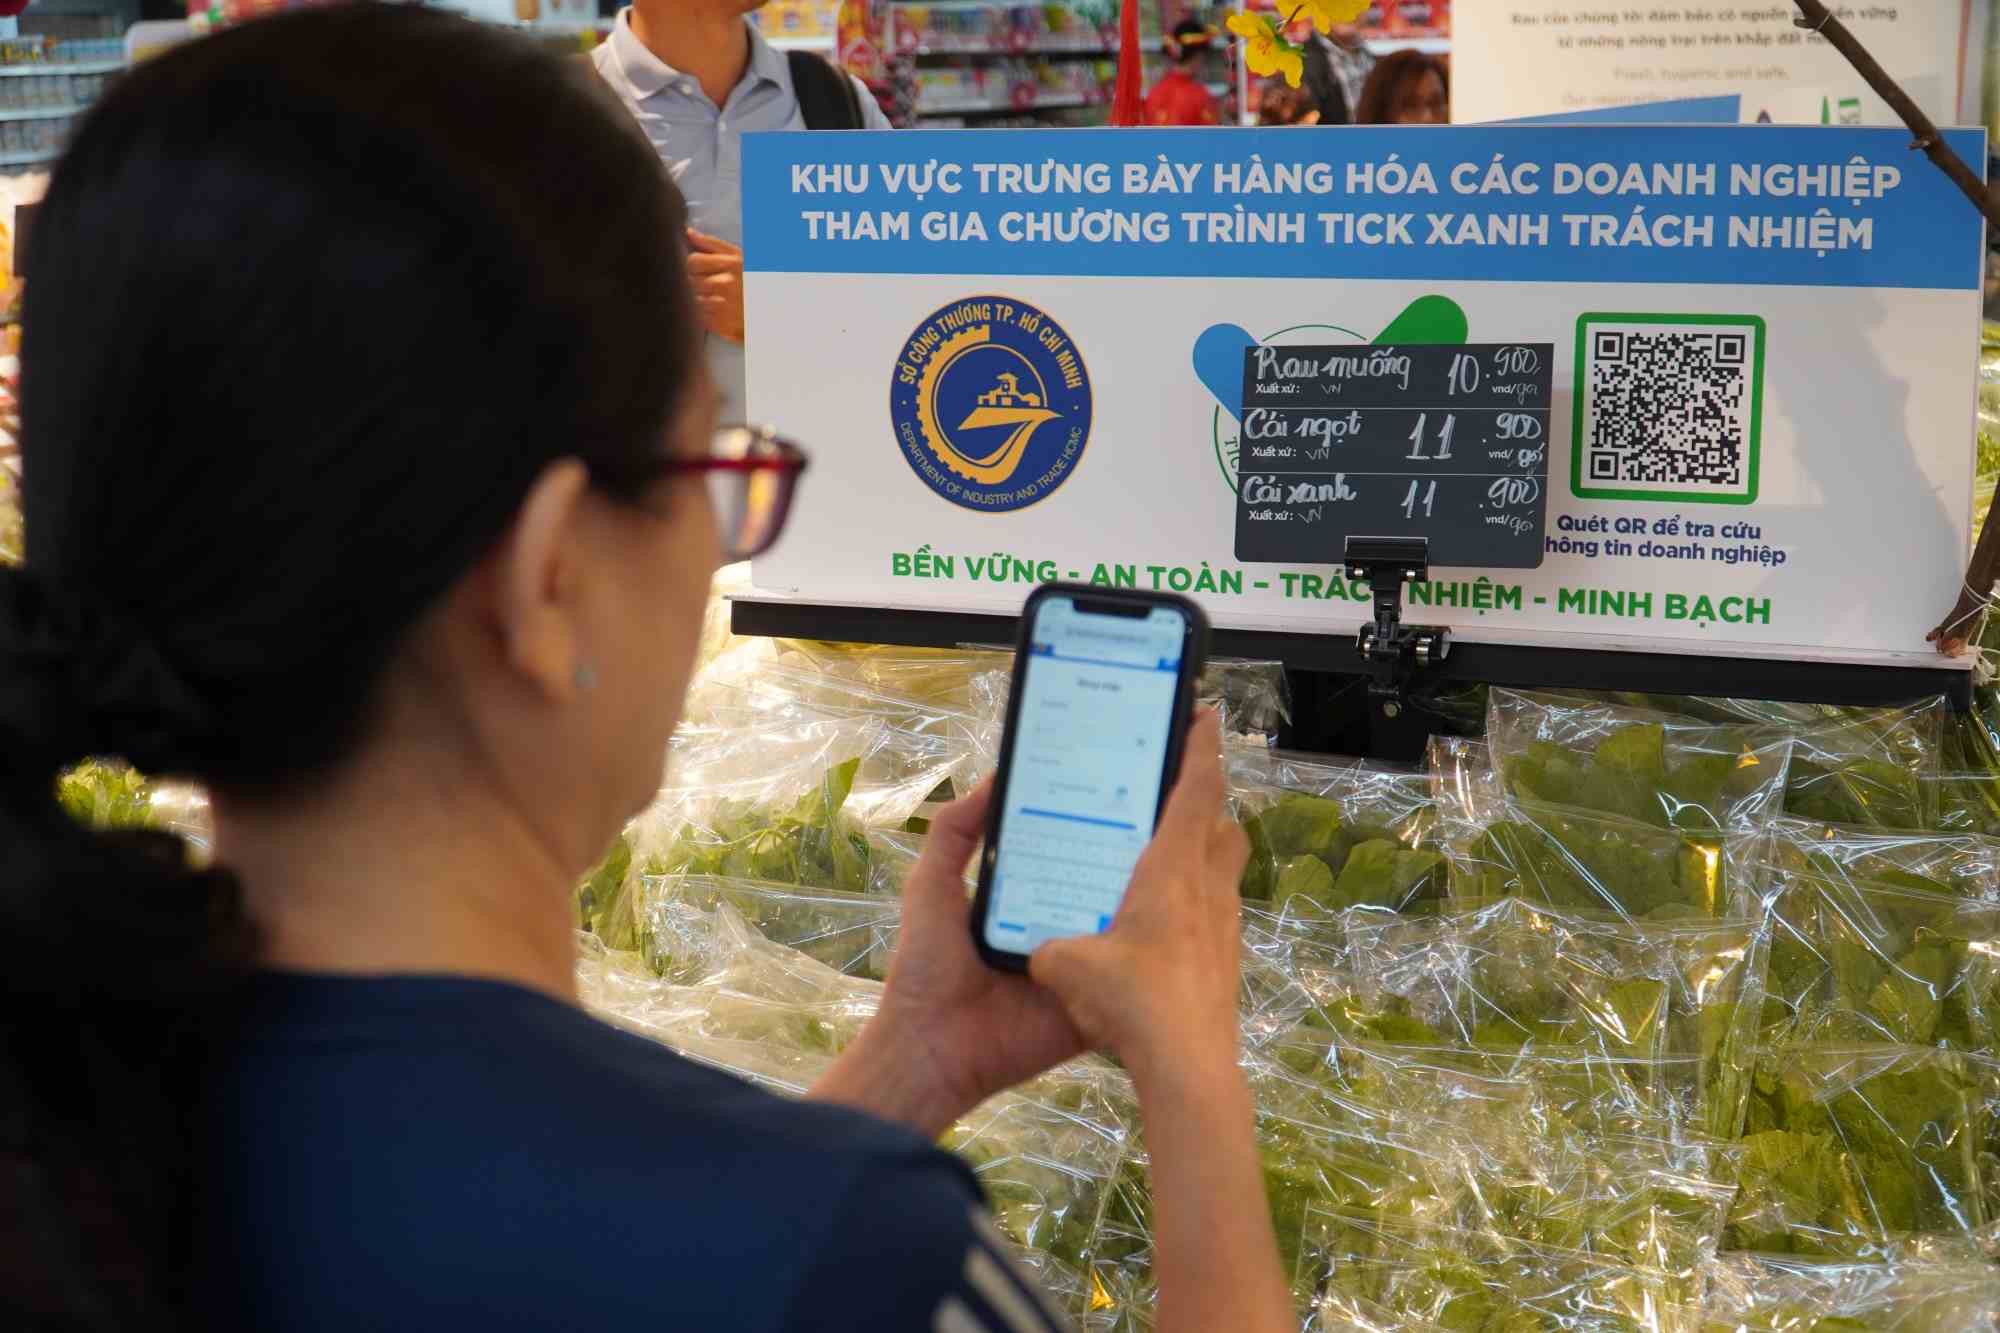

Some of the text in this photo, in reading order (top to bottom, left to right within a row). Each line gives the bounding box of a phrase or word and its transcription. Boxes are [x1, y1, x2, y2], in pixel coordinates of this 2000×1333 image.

[792, 153, 1901, 205] KHU VỰC TRƯNG BÀY HÀNG HÓA CÁC DOANH NGHIỆP
[802, 203, 1873, 257] THAM GIA CHƯƠNG TRÌNH TICK XANH TRÁCH NHIỆM
[899, 303, 1084, 390] SỞ CÔNG THƯƠNG TP. HỒ CHÍ MINH
[1253, 345, 1318, 380] Rau
[1256, 382, 1279, 394] Xuất
[1252, 445, 1276, 457] Xuất
[1305, 447, 1330, 460] VN
[1294, 410, 1363, 448] ngọt
[1405, 412, 1456, 460] 11
[901, 421, 1084, 506] DEPARTMENT OF INDUSTRY AND TRADE HCMC
[1249, 509, 1272, 521] Xuất
[1298, 505, 1322, 524] VN
[1286, 473, 1357, 505] xanh
[1400, 479, 1437, 519] 11
[1557, 514, 1761, 540] Quét QR để tra cứu
[1546, 535, 1787, 567] hông tin doanh nghiệp
[892, 544, 954, 579] BỀN
[965, 552, 1057, 585] VỮNG
[1089, 562, 1137, 590] AN
[1147, 561, 1244, 594] TOÀN
[1279, 568, 1372, 603] TRÁC
[1408, 576, 1523, 616] NHIỆM
[1557, 587, 1653, 619] MINH
[1664, 593, 1772, 628] BẠCH
